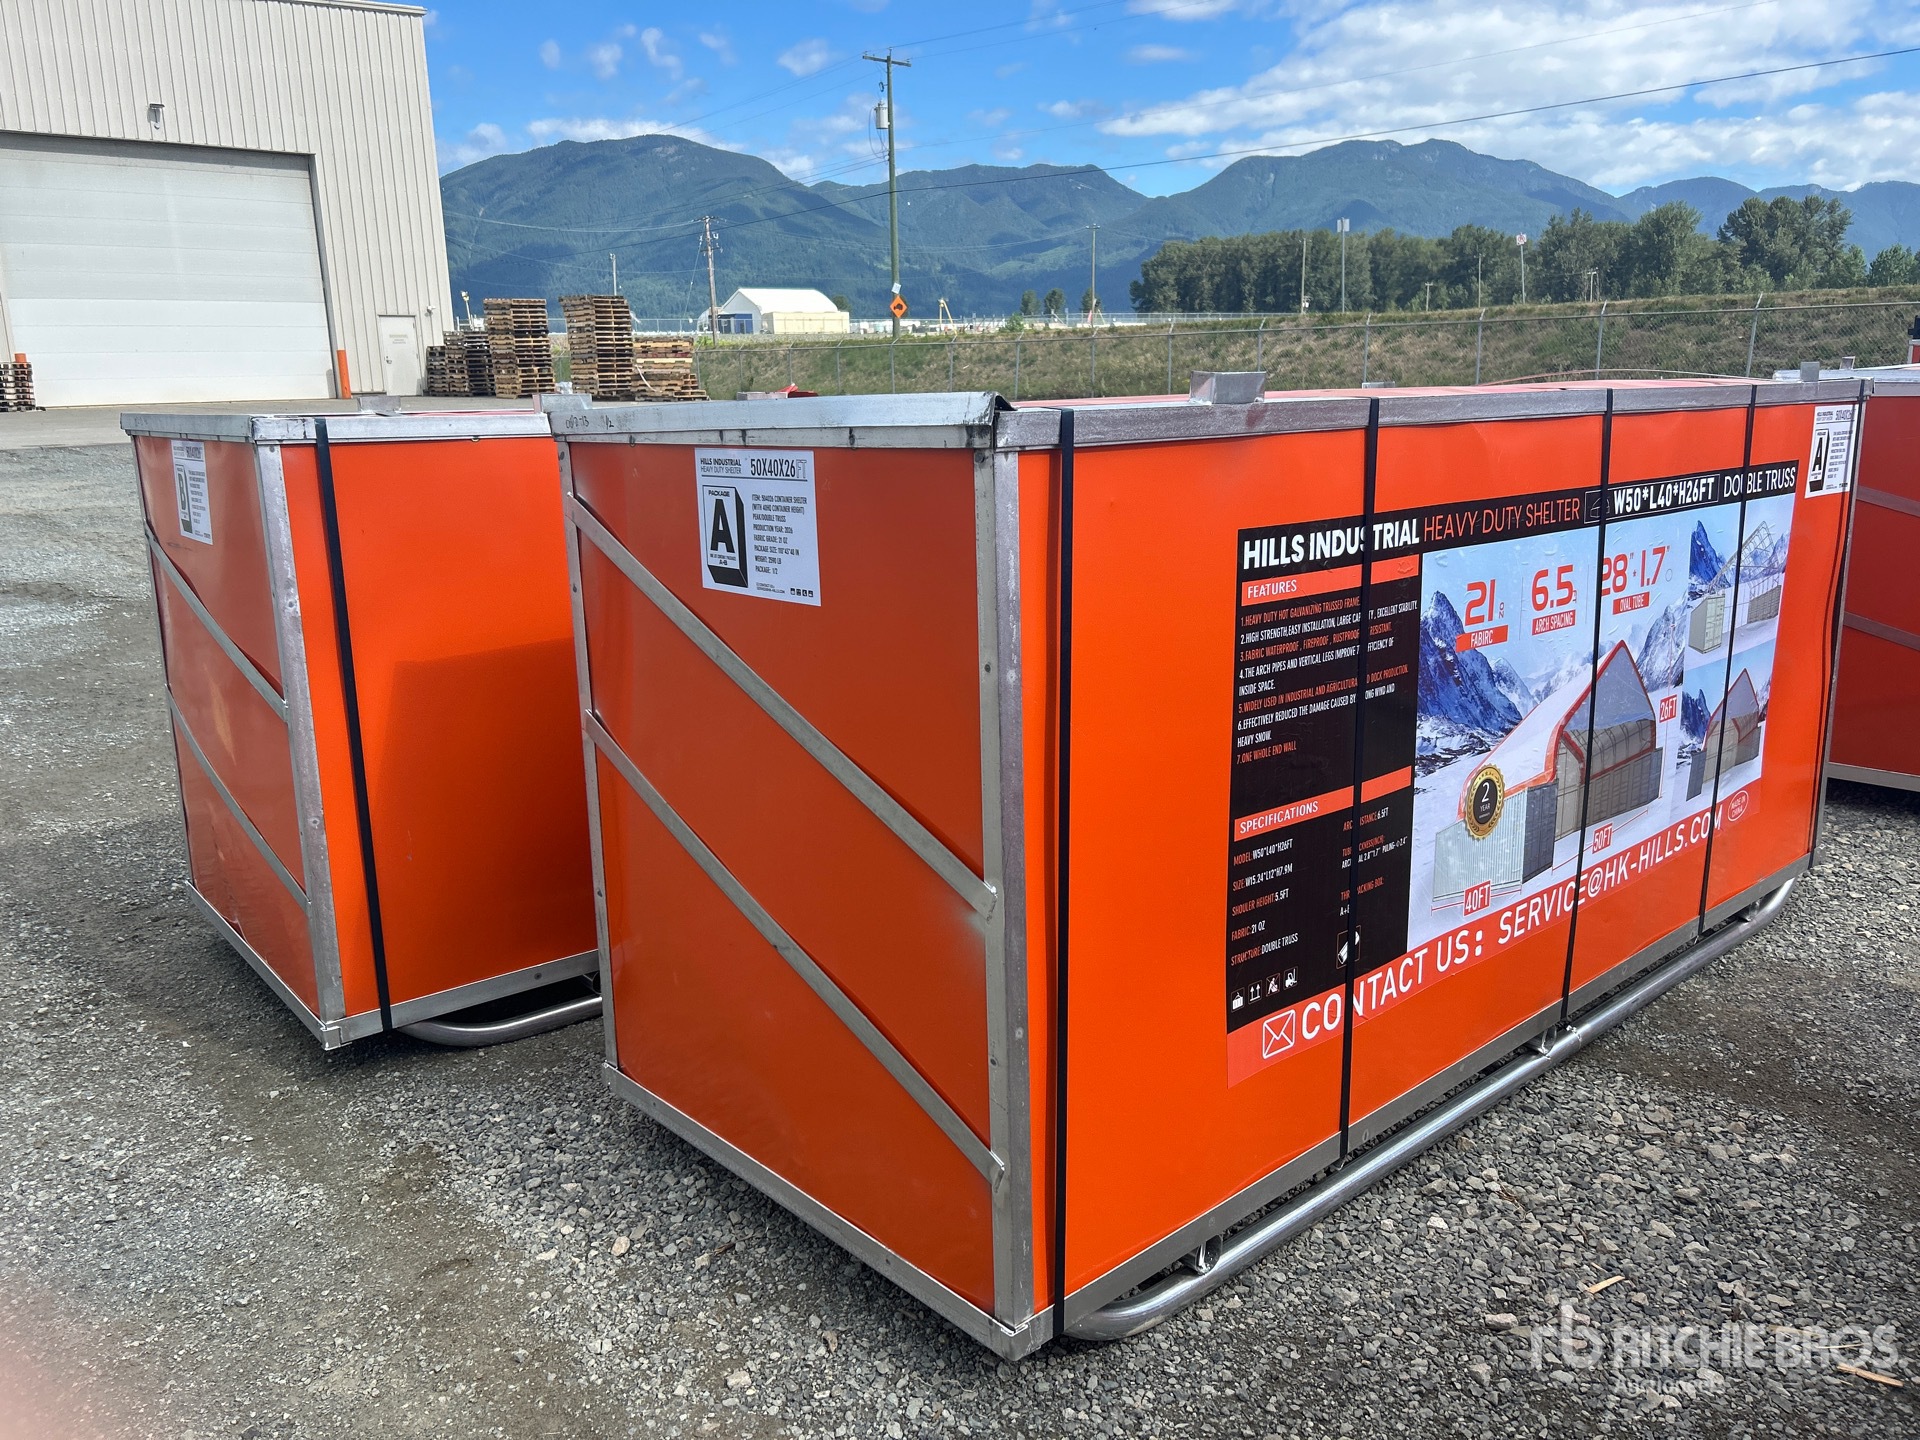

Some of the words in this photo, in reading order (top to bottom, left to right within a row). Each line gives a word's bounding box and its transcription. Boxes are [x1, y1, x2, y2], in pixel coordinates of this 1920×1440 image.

[708, 490, 730, 498] PACKAGE
[710, 499, 735, 553] A
[1243, 535, 1305, 570] HILLS
[1309, 518, 1420, 560] INDUSTRIAL
[1424, 510, 1478, 542] HEAVY
[1482, 505, 1522, 534] DUTY
[1526, 497, 1580, 527] SHELTER
[1766, 466, 1796, 490] TRUSS
[1248, 579, 1297, 599] FEATURES
[1532, 564, 1573, 611] 6.5
[1241, 614, 1262, 626] 1.HEAVY
[1264, 611, 1277, 623] DUTY
[1279, 609, 1289, 621] HOT
[1323, 599, 1343, 612] TRUSSED
[1465, 579, 1496, 626] 21
[1620, 597, 1631, 612] OVAL
[1632, 594, 1644, 609] TUBE
[1241, 632, 1259, 644] 2.HIGH
[1337, 614, 1352, 626] LARGE
[1377, 604, 1397, 618] EXCELLENT
[1535, 617, 1549, 634] ARCH
[1550, 612, 1573, 630] SPACING
[1240, 648, 1264, 662] 3.FABRIC
[1266, 641, 1299, 656] WATERPROOF
[1303, 635, 1329, 649] FIREPROOF
[1333, 629, 1360, 643] RUSTPROOF
[1470, 630, 1493, 648] FABIRC
[1239, 666, 1255, 679] 4.THE
[1256, 662, 1270, 676] ARCH
[1272, 660, 1286, 672] PIPES
[1287, 658, 1297, 669] AND
[1299, 653, 1321, 668] VERTICAL
[1322, 650, 1334, 662] LEGS
[1335, 646, 1355, 659] IMPROVE
[1367, 638, 1387, 652] FFICIENCY
[1388, 637, 1394, 647] OF
[1239, 683, 1256, 696] INSIDE
[1257, 679, 1276, 693] SPACE.
[1264, 696, 1276, 708] USED
[1278, 694, 1284, 705] IN
[1285, 688, 1314, 703] INDUSTRIAL
[1315, 685, 1325, 695] AND
[1275, 708, 1298, 722] REDUCED
[1299, 705, 1308, 716] THE
[1309, 701, 1329, 713] DAMAGE
[1331, 696, 1348, 709] CAUSED
[1350, 694, 1356, 704] BY
[1386, 683, 1395, 694] AND
[1660, 697, 1677, 720] 26FT
[1237, 733, 1254, 747] HEAVY
[1237, 751, 1252, 764] 7.ONE
[1254, 746, 1271, 760] WHOLE
[1272, 744, 1282, 754] END
[1284, 740, 1296, 752] WALL
[1482, 782, 1489, 803] 2
[1240, 801, 1318, 833] SPECIFICATIONS
[1480, 803, 1490, 812] YEAR
[1594, 826, 1612, 852] 50FT
[1232, 900, 1255, 916] SHOULER
[1465, 883, 1490, 912] 40FT
[1258, 920, 1266, 931] OZ
[1282, 933, 1298, 947] TRUSS
[1302, 947, 1428, 1040] CONTACT
[1436, 929, 1483, 972] US:
